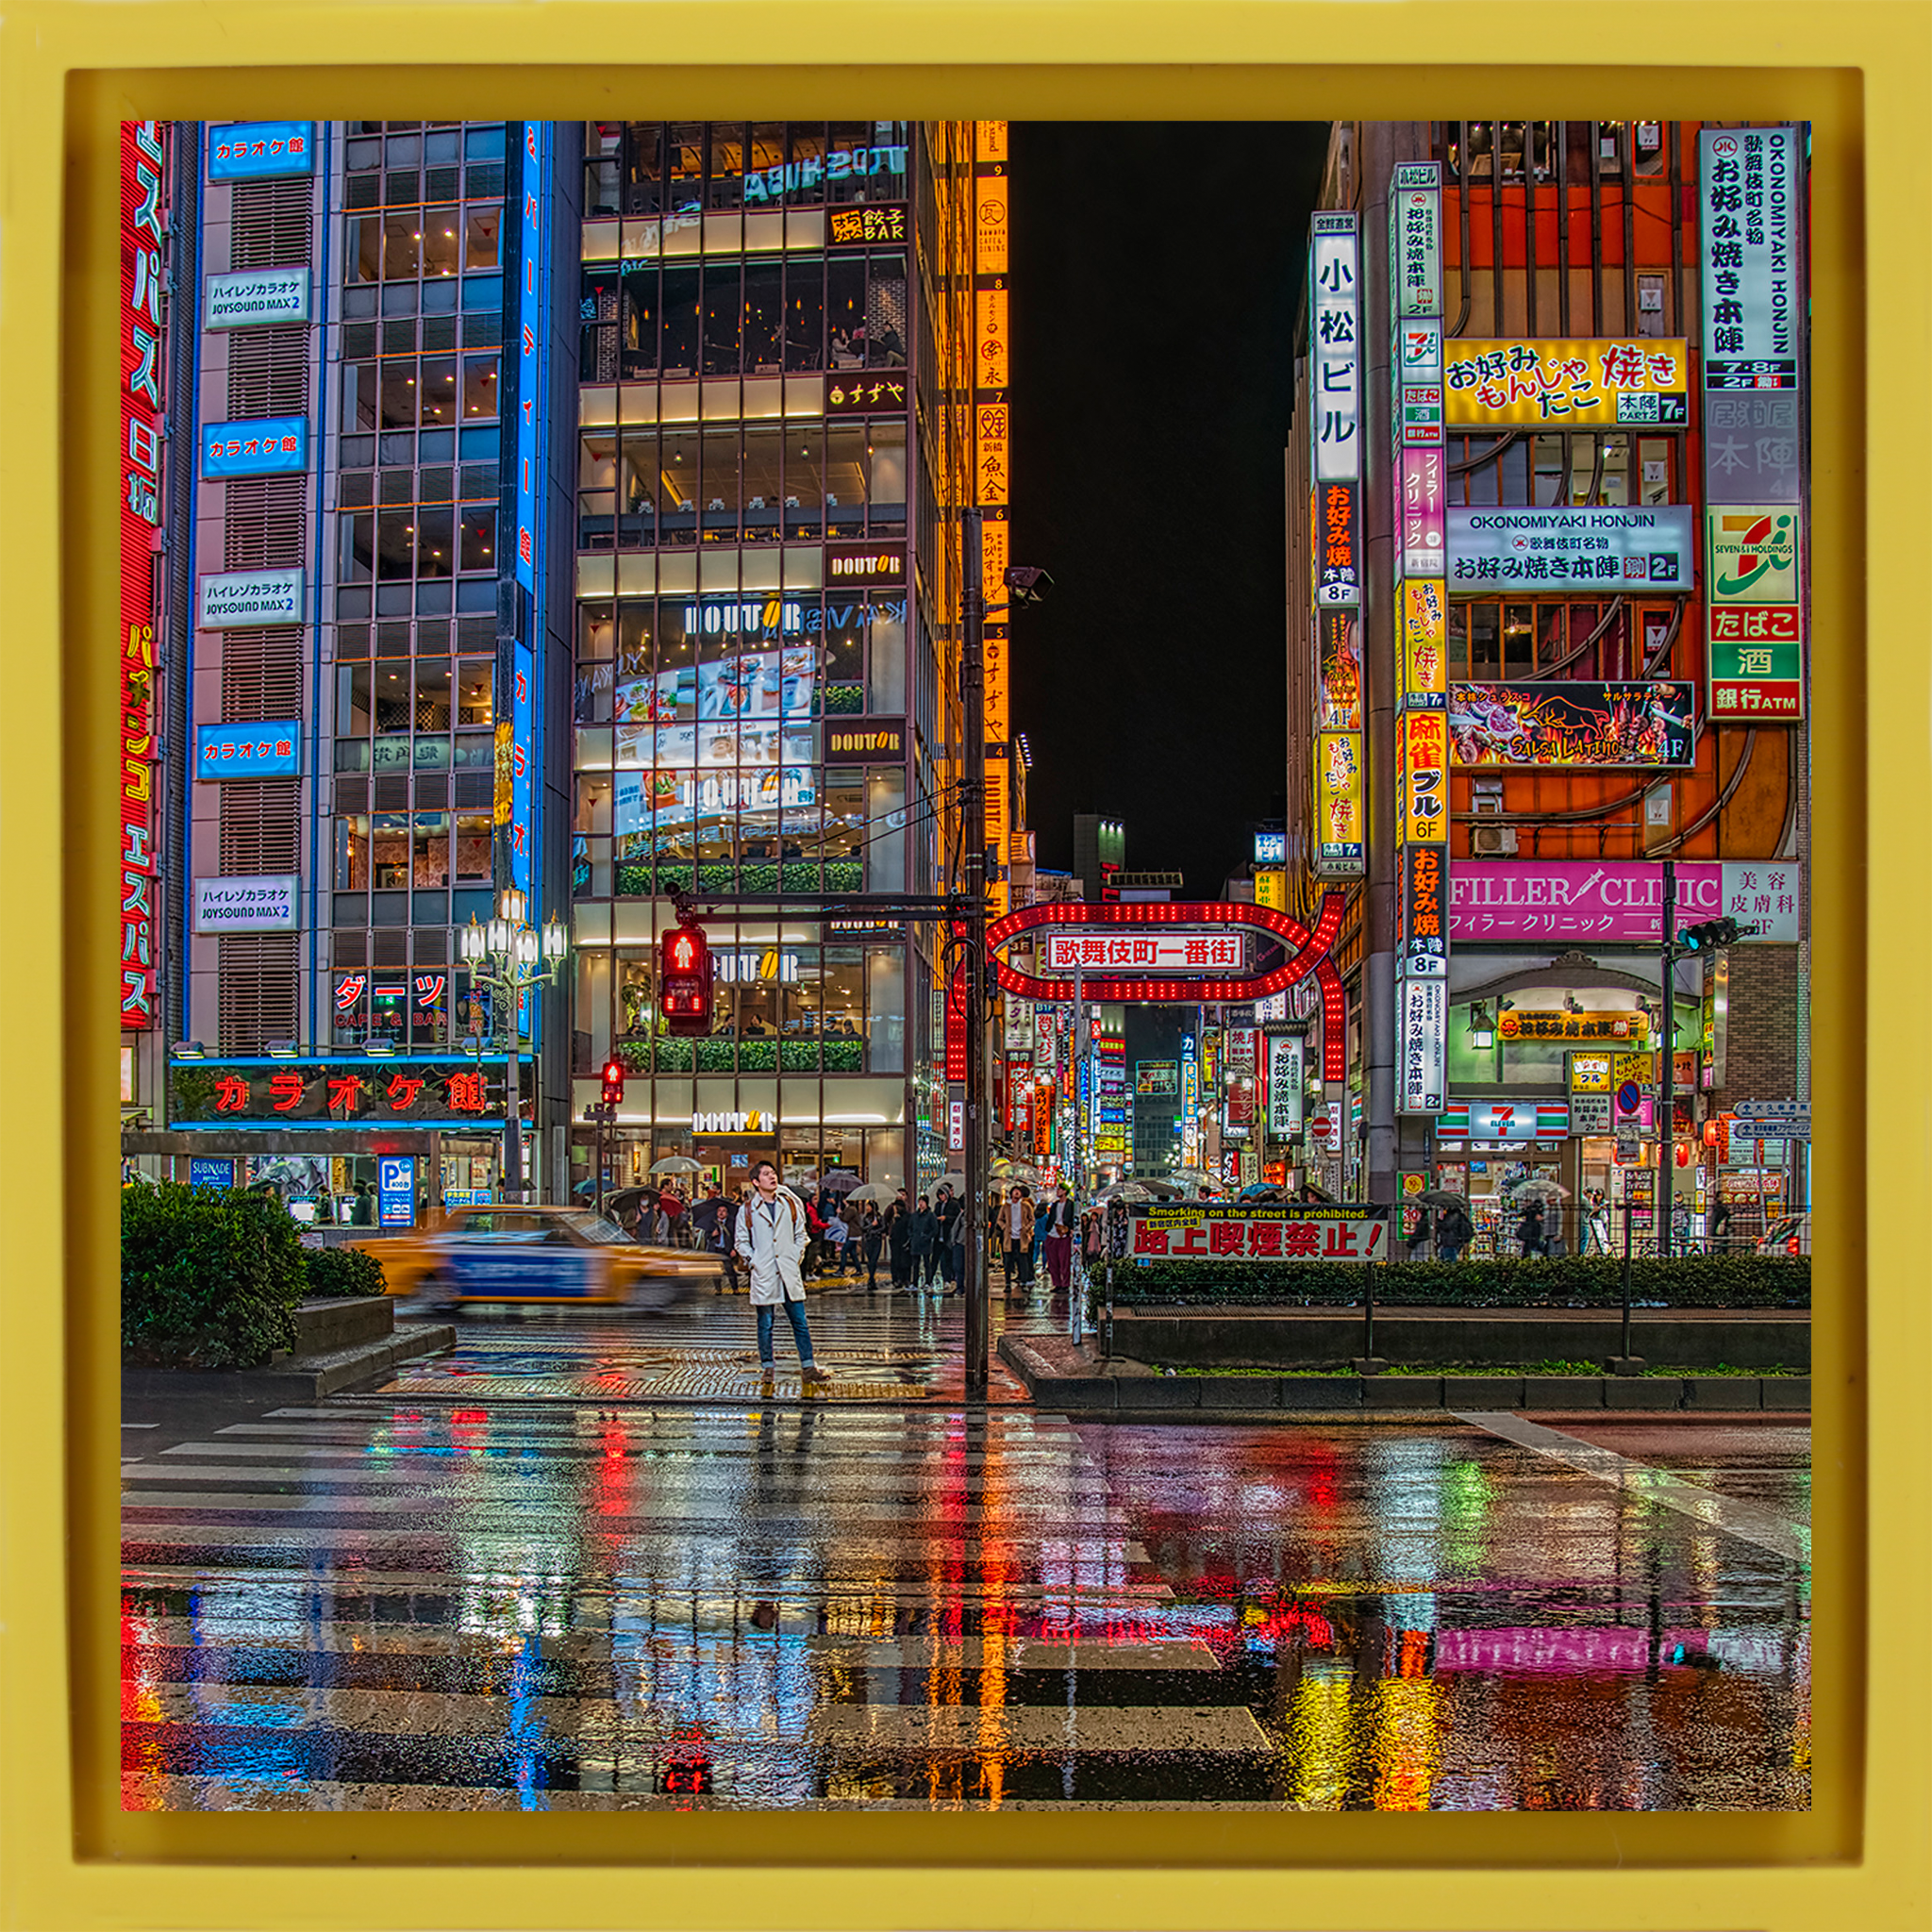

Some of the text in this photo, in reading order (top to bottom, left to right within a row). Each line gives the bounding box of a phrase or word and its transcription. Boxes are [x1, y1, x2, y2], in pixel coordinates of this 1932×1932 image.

[217, 138, 305, 160] カラオケ館
[993, 164, 1003, 176] 9
[864, 225, 905, 240] BAR
[1769, 134, 1789, 355] OKONOMIYAKI HONJIN
[1709, 158, 1744, 355] お好み焼き本陣
[213, 281, 300, 299] ハイレゾカラオケ
[993, 279, 1003, 291] 8
[212, 300, 265, 315] JOYSOUND
[1319, 258, 1357, 444] 小松ビル
[1447, 346, 1539, 390] お好み
[1599, 345, 1676, 389] 焼き
[849, 380, 905, 405] すずや
[1477, 356, 1587, 409] もんじゃ
[1724, 377, 1754, 389] 2F
[995, 391, 1004, 403] 7
[1538, 381, 1600, 418] たこ
[1619, 395, 1657, 408] 本陣
[1661, 401, 1685, 422] 7F
[209, 436, 298, 458] カラオケ館
[1710, 435, 1796, 476] 本陣
[1425, 453, 1439, 513] フィラー
[1407, 472, 1422, 548] クリニック
[1325, 485, 1353, 567] お好み焼
[1469, 514, 1656, 529] OKONOMIYAKI HONJIN
[1751, 544, 1793, 555] HOLDINGS
[831, 554, 901, 575] DOUTOR
[1453, 556, 1621, 580] お好み焼き本陣
[1651, 557, 1678, 577] 2F
[207, 582, 294, 598] ハイレゾカラオケ
[1327, 586, 1351, 601] 8F
[206, 600, 259, 616] JOYSOUND
[1715, 610, 1794, 638] たばこ
[1412, 645, 1438, 689] 焼き
[1737, 647, 1774, 675] 酒
[1456, 691, 1531, 703] 本格シュラスコ
[1603, 691, 1682, 702] サルサラティーノ
[1328, 708, 1352, 726] 4F
[204, 740, 291, 760] カラオケ館
[830, 731, 900, 751] DOUTOR
[1510, 735, 1559, 758] SALSA
[1657, 739, 1684, 758] 4F
[1408, 713, 1443, 820] 麻雀ブル
[1328, 798, 1354, 841] 焼き
[1415, 823, 1438, 839] 6F
[1738, 870, 1787, 891] 美容
[203, 889, 290, 904] ハイレゾカラオケ
[1412, 849, 1441, 937] お好み焼
[1448, 878, 1570, 906] FILLER
[202, 906, 256, 920] JOYSOUND
[1729, 893, 1795, 914] 皮膚科
[123, 824, 150, 1016] エスパス
[1448, 914, 1614, 931] フィラー クリニック
[1055, 940, 1236, 965] 歌舞伎町一番街
[1413, 957, 1438, 974] 8F
[335, 974, 446, 1010] ダーツ
[335, 1012, 382, 1027] CAFE
[412, 1012, 448, 1026] BAR
[1407, 993, 1424, 1095] お好み焼き本陣
[215, 1073, 486, 1112] カラオケ館
[384, 1164, 400, 1189] P
[1208, 1209, 1224, 1218] on
[1226, 1208, 1247, 1219] the
[1250, 1208, 1287, 1219] street
[1290, 1208, 1300, 1219] is
[1304, 1208, 1369, 1221] prohibited.
